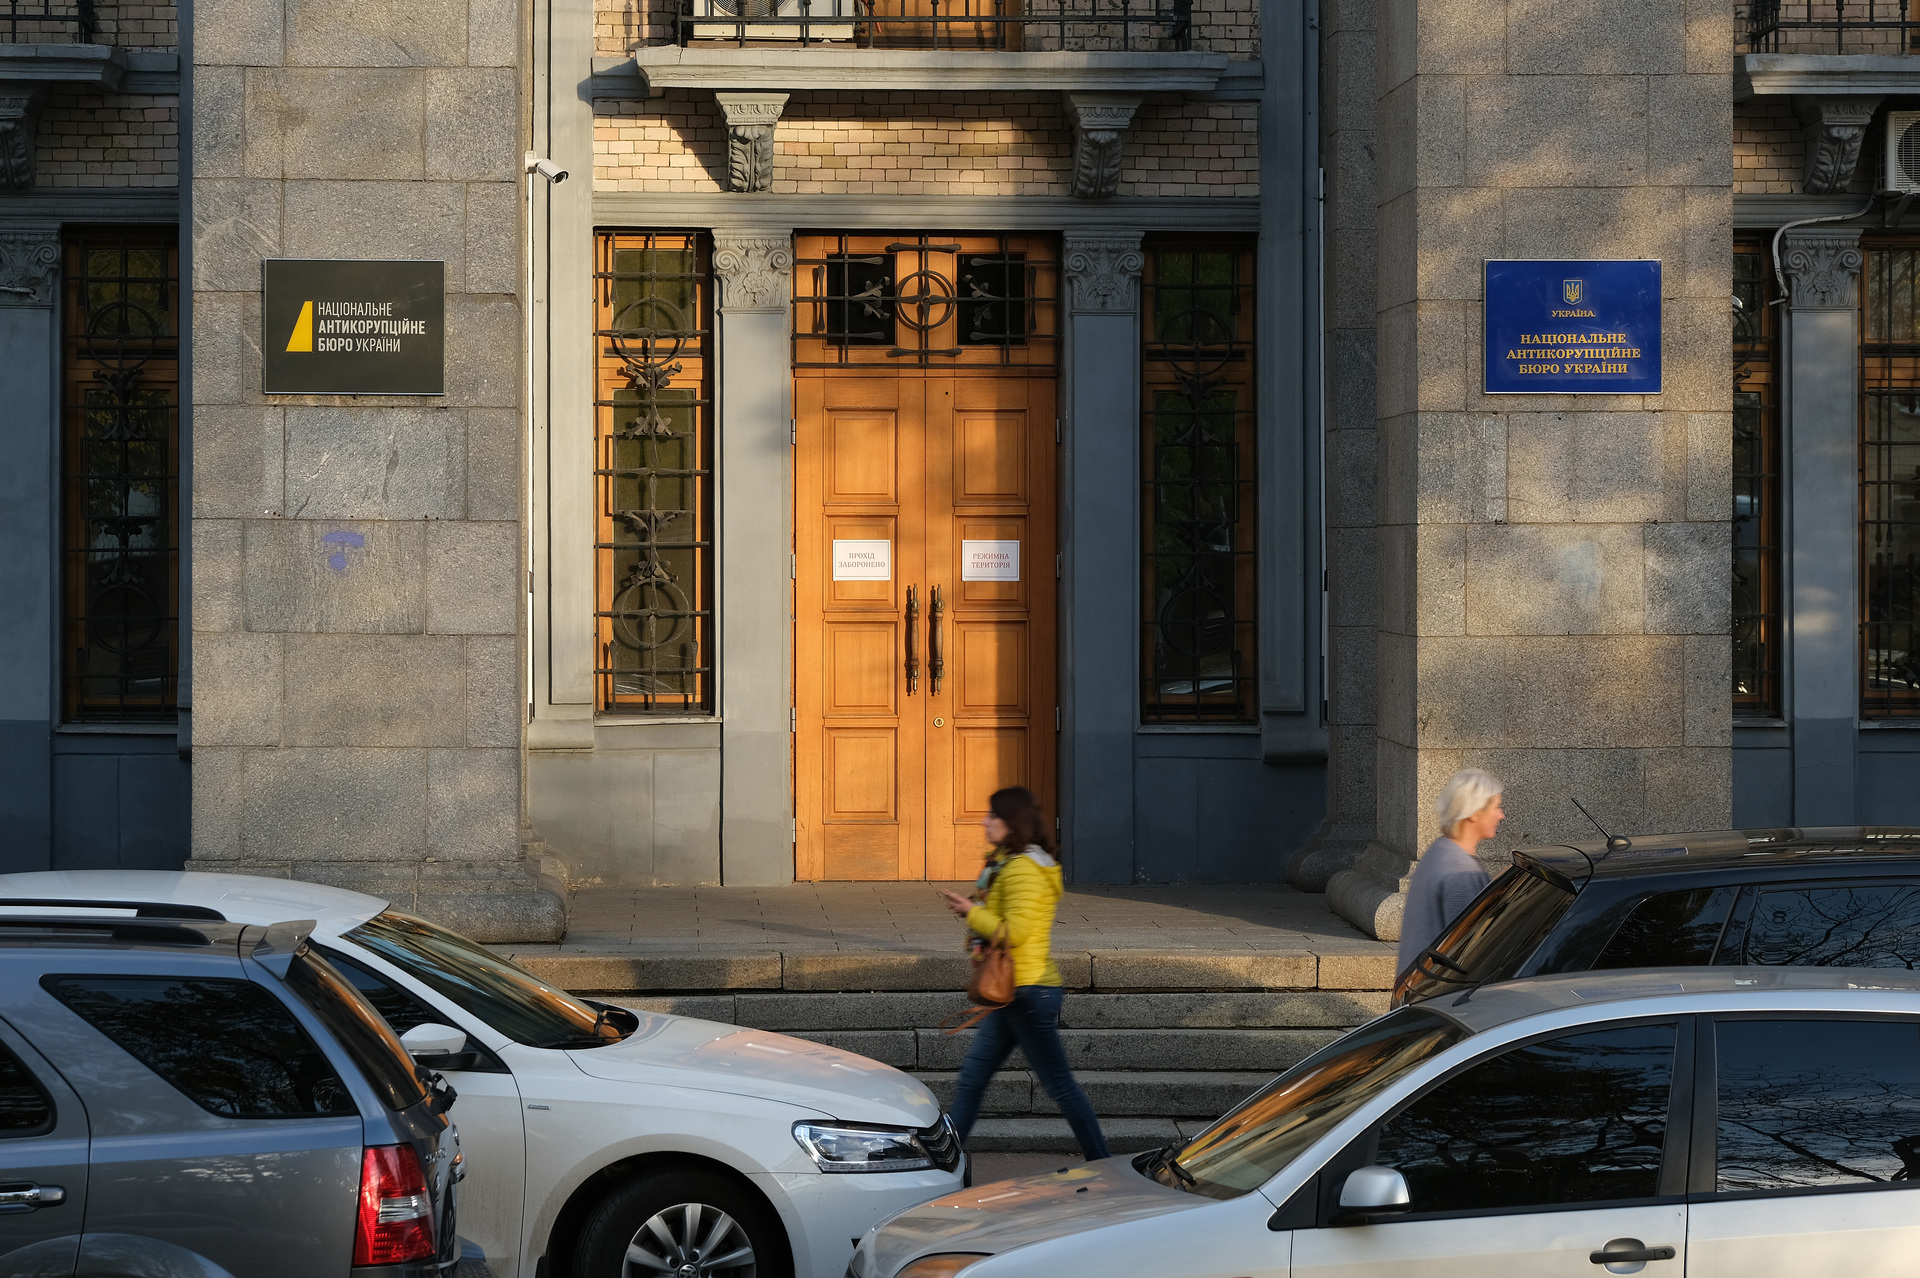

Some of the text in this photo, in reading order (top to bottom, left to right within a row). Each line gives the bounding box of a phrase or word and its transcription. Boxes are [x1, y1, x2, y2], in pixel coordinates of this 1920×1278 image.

[318, 302, 392, 317] НАЦІОНАЛЬНЕ
[1551, 309, 1595, 318] УКРАЇНА
[318, 318, 426, 336] АНТИКОРУПЦІЙНЕ
[318, 336, 401, 352] БЮРО УКРАЇНИ
[1520, 333, 1627, 345] НАЦІОНАЛЬНЕ
[1506, 346, 1641, 360] АНТИКОРУПЦІЙНЕ
[1519, 361, 1628, 374] БЮРО УКРАЇНИ
[971, 561, 1011, 569] ТЕРИТОРІЯ
